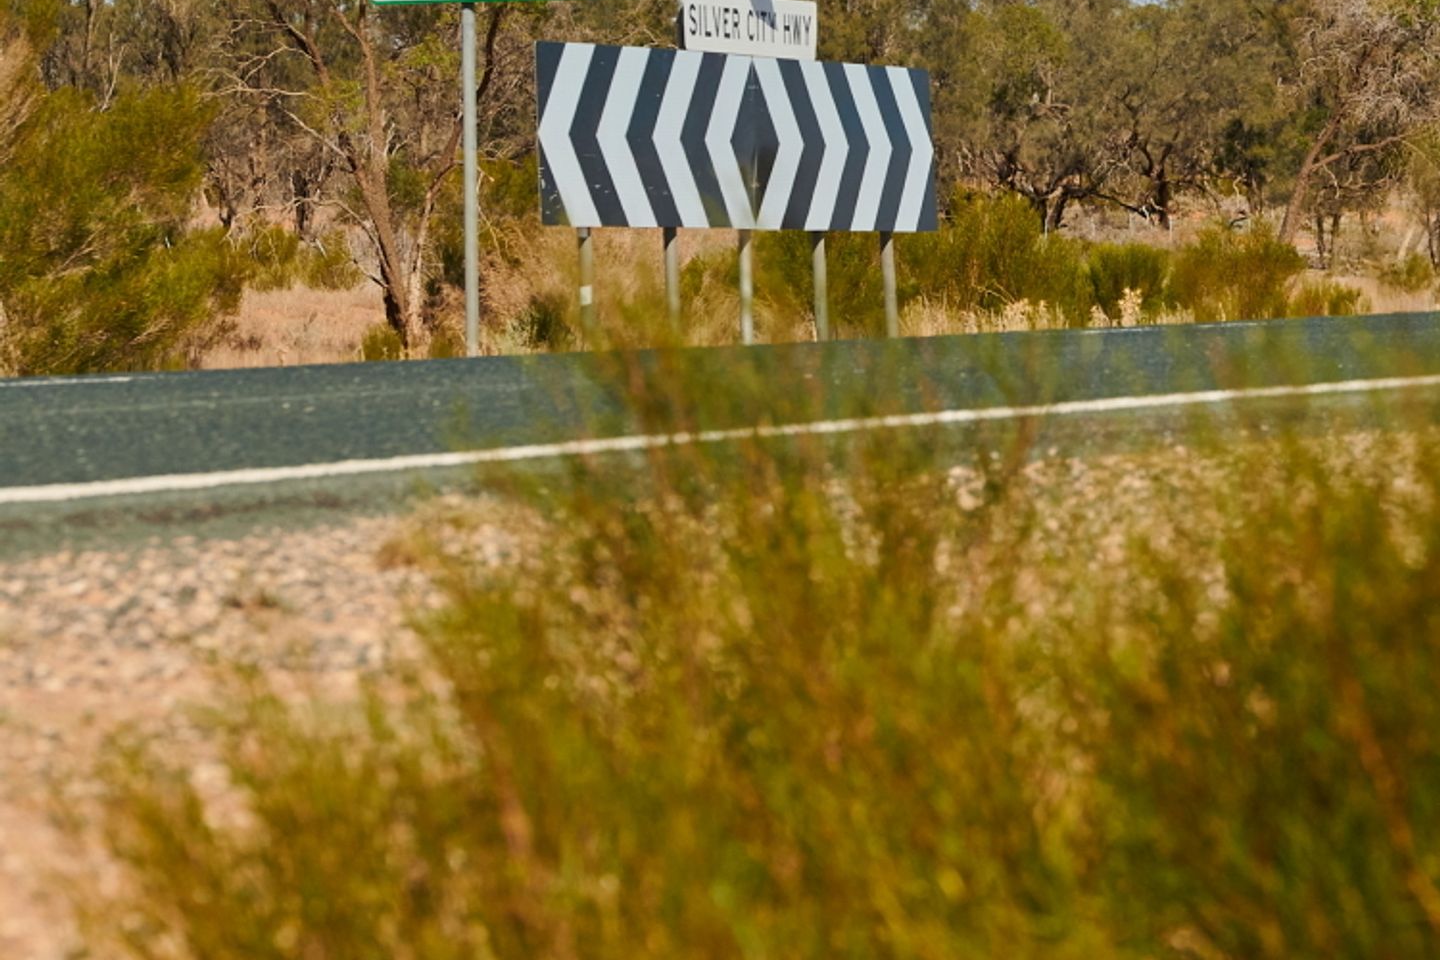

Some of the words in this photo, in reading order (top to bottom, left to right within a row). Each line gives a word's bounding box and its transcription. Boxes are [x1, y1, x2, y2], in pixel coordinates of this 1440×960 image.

[688, 3, 740, 40] SILVER
[746, 9, 776, 43] CITY
[783, 13, 812, 45] HWY
